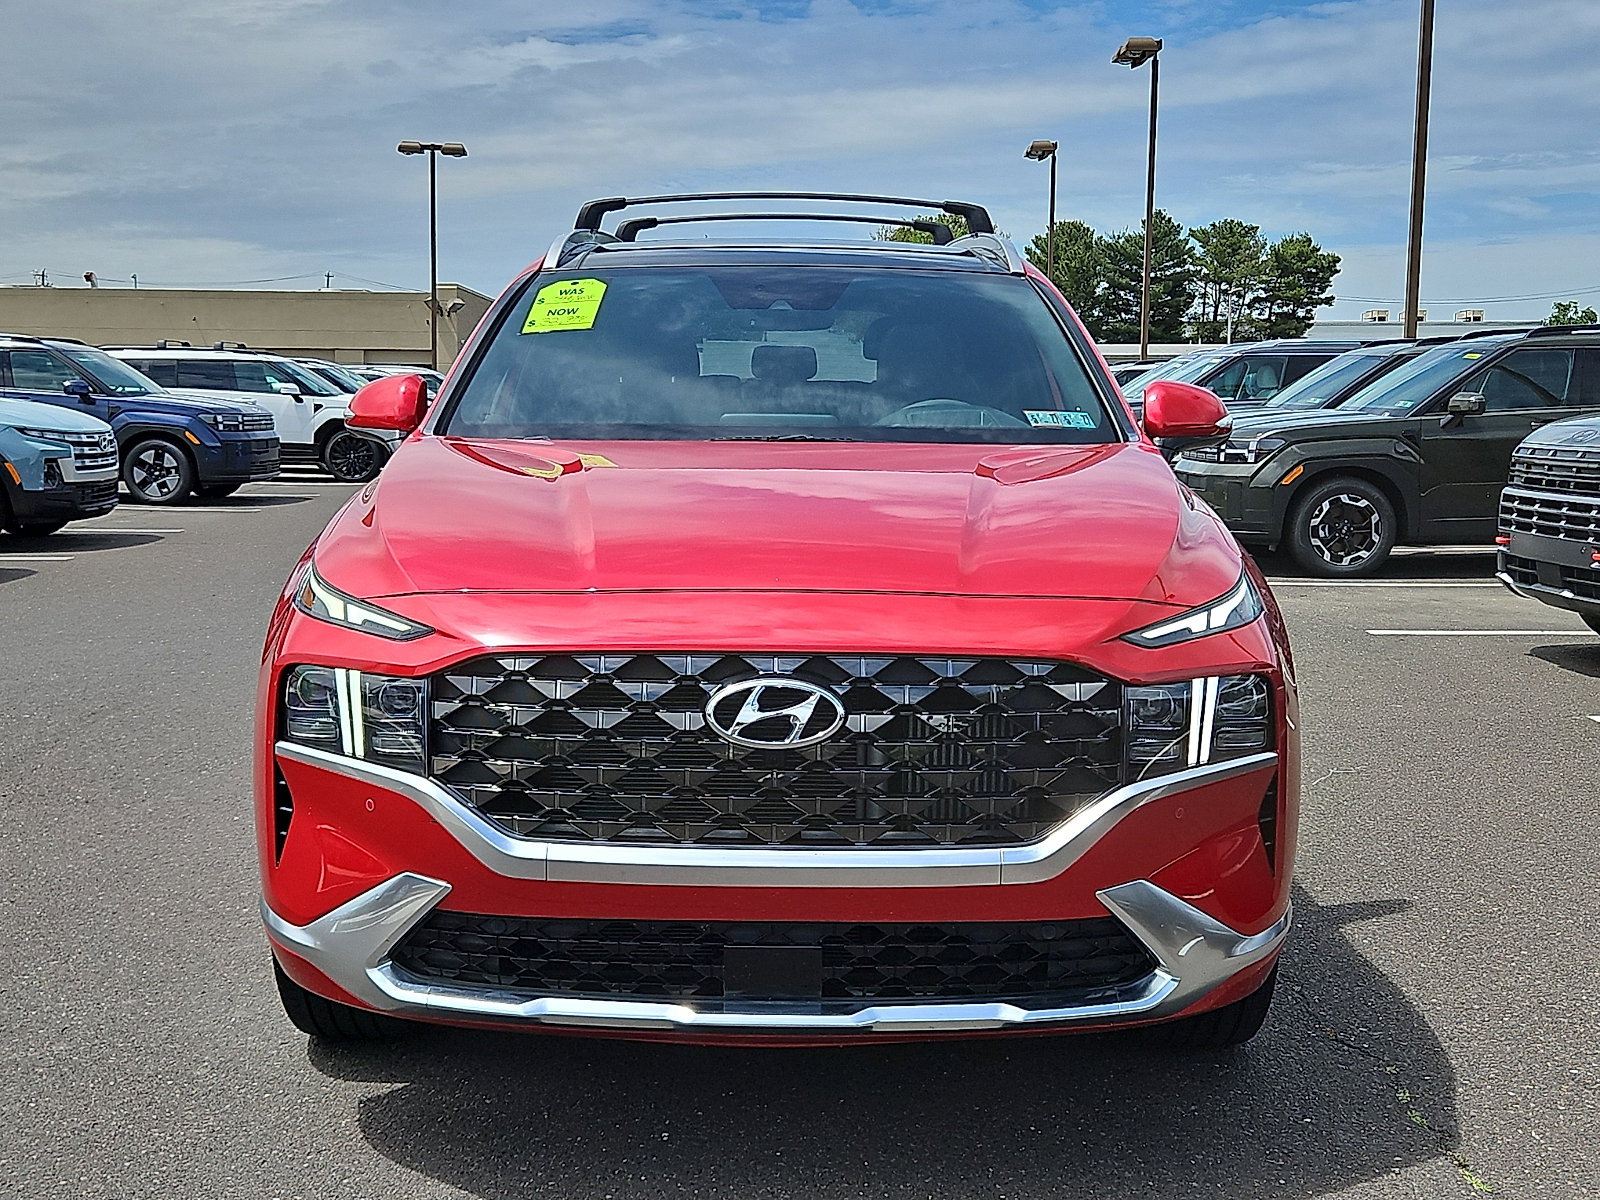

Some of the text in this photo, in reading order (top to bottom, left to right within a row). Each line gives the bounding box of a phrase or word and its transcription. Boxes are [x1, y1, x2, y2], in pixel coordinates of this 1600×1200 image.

[559, 287, 585, 296] WAS
[536, 297, 546, 305] $
[546, 307, 580, 317] NOW
[527, 319, 537, 328] $
